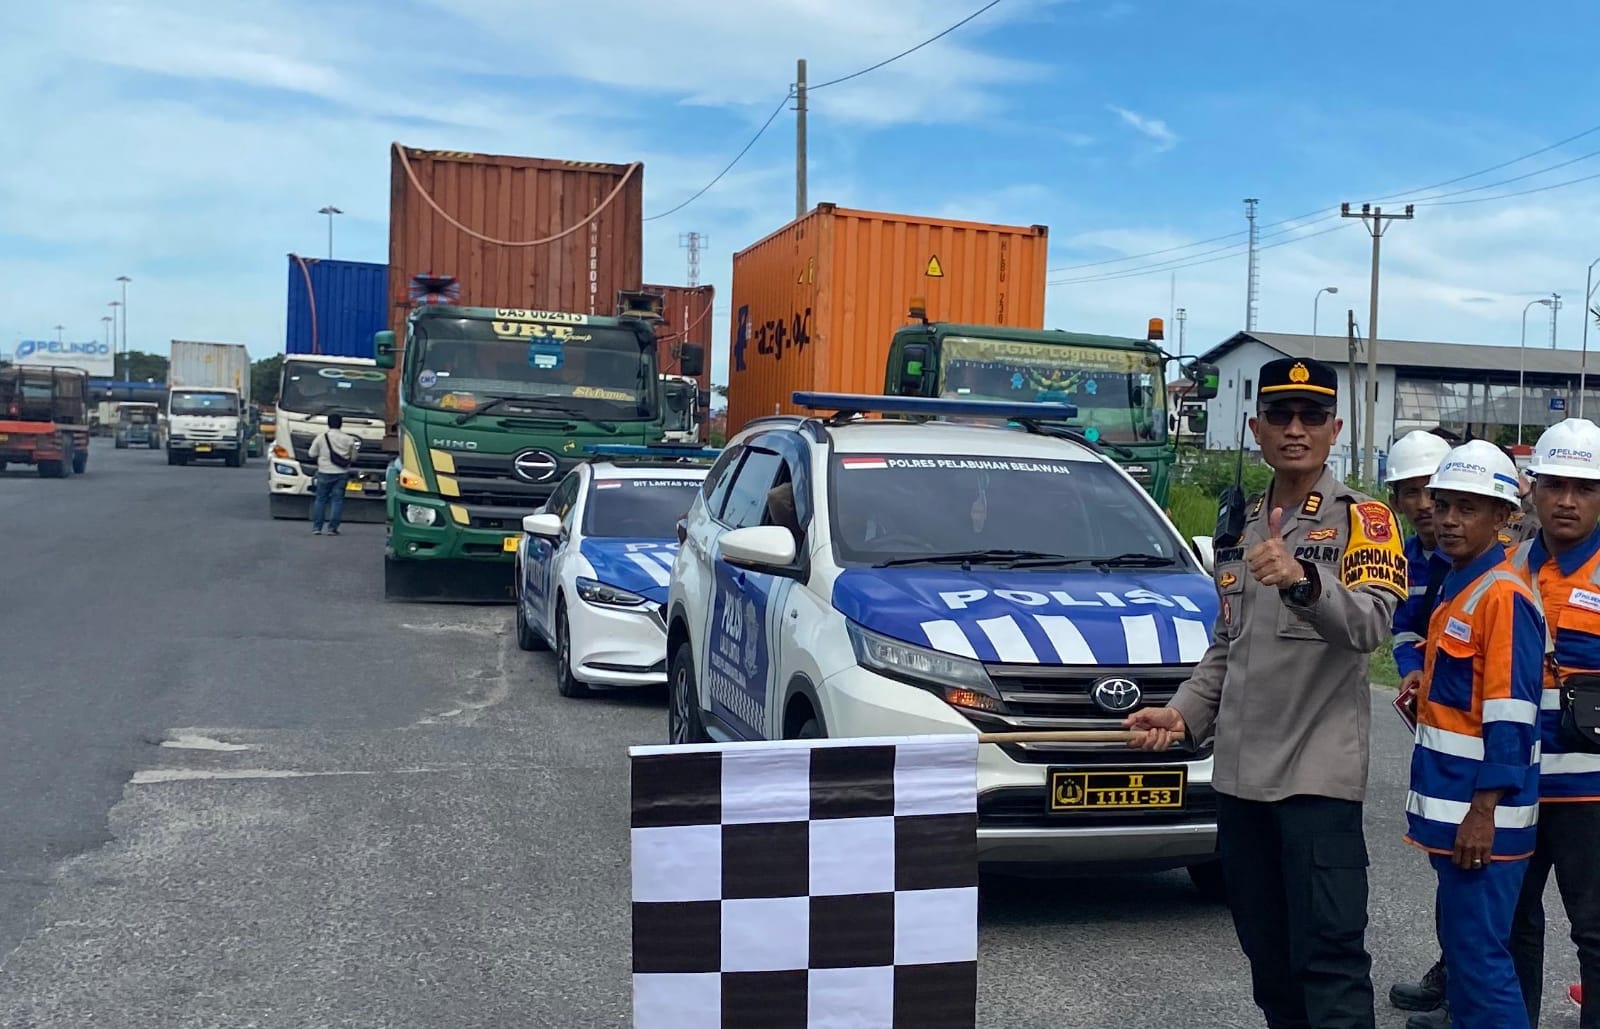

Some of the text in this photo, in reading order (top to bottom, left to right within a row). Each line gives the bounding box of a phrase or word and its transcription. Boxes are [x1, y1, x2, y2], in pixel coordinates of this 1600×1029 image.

[491, 321, 573, 339] URT
[37, 341, 110, 354] PELINDO
[1049, 347, 1127, 364] Logistics
[433, 439, 478, 449] HINO
[1557, 448, 1592, 459] PELINDO
[890, 459, 1070, 475] POLRES PELABUHAN BELAWAN
[1452, 462, 1487, 473] PELINDO
[1294, 547, 1339, 562] POLRI
[1365, 566, 1390, 582] TOBA
[938, 589, 1201, 613] POLISI
[1128, 775, 1144, 787] II
[1096, 790, 1172, 805] 1111-53
